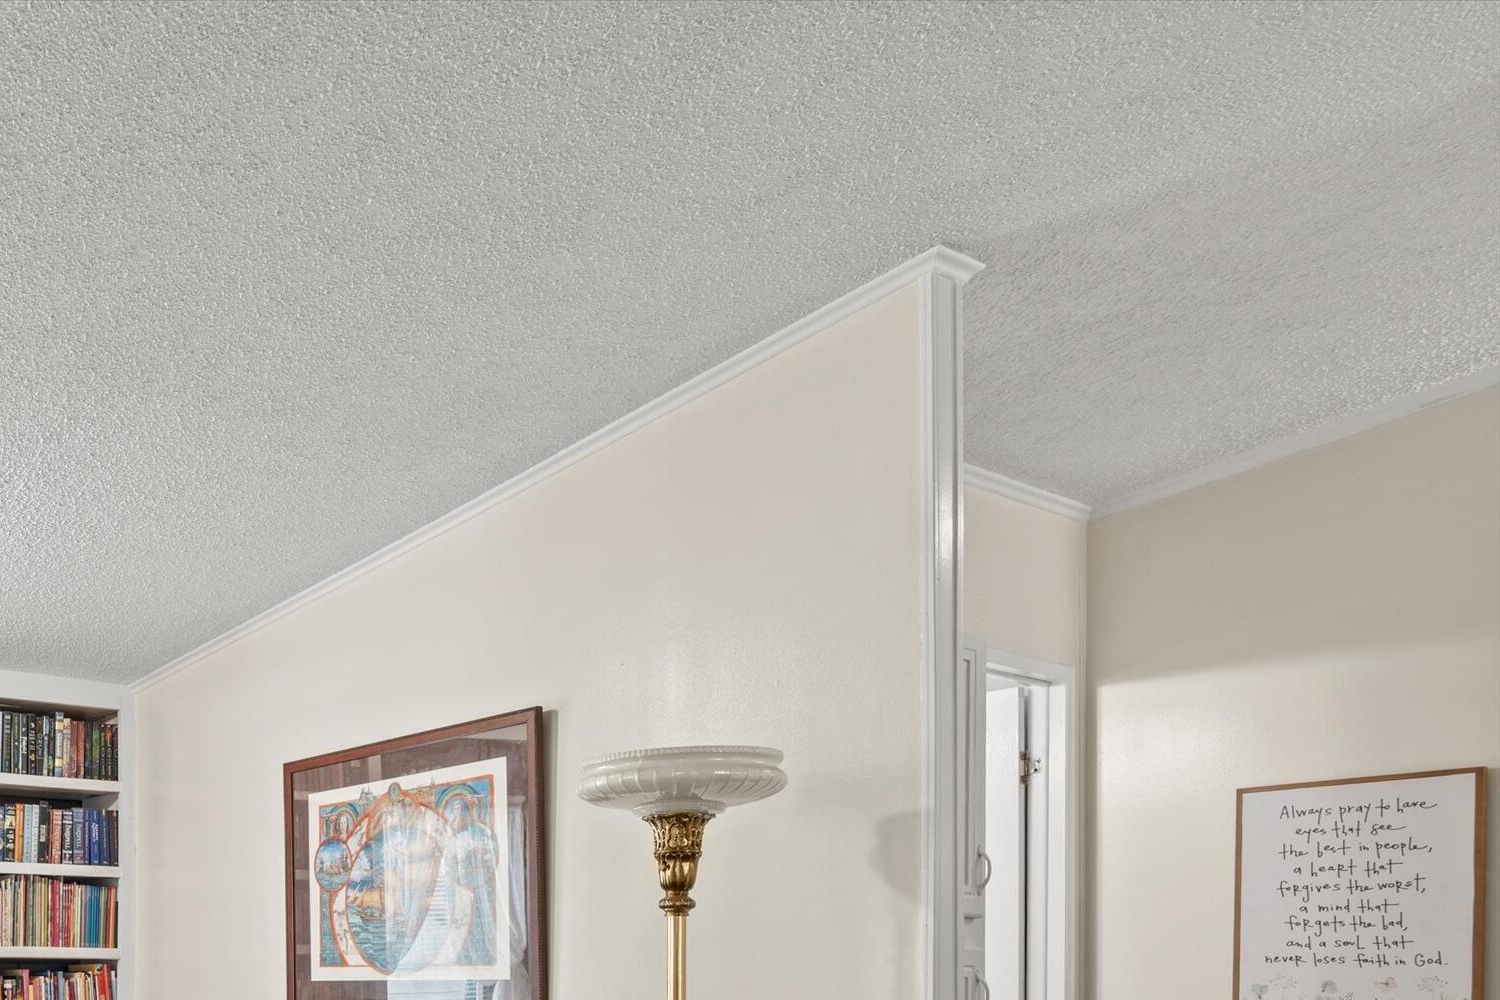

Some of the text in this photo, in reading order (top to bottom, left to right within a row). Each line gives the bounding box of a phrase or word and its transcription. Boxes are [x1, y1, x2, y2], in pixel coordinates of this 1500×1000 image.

[1279, 798, 1438, 825] Always pray to have
[1295, 821, 1407, 844] eyes that see
[1278, 837, 1433, 860] the best in people,
[1293, 867, 1302, 875] a
[1365, 859, 1404, 877] that
[1346, 879, 1374, 896] the
[1299, 899, 1400, 914] a mind that
[1350, 915, 1376, 932] the
[1381, 912, 1409, 931] bad,
[1285, 936, 1311, 949] and
[1318, 939, 1327, 948] a
[1373, 935, 1415, 950] that
[1313, 952, 1346, 967] loses
[1353, 951, 1390, 968] faith
[1394, 958, 1406, 966] in
[1414, 950, 1449, 968] God.
